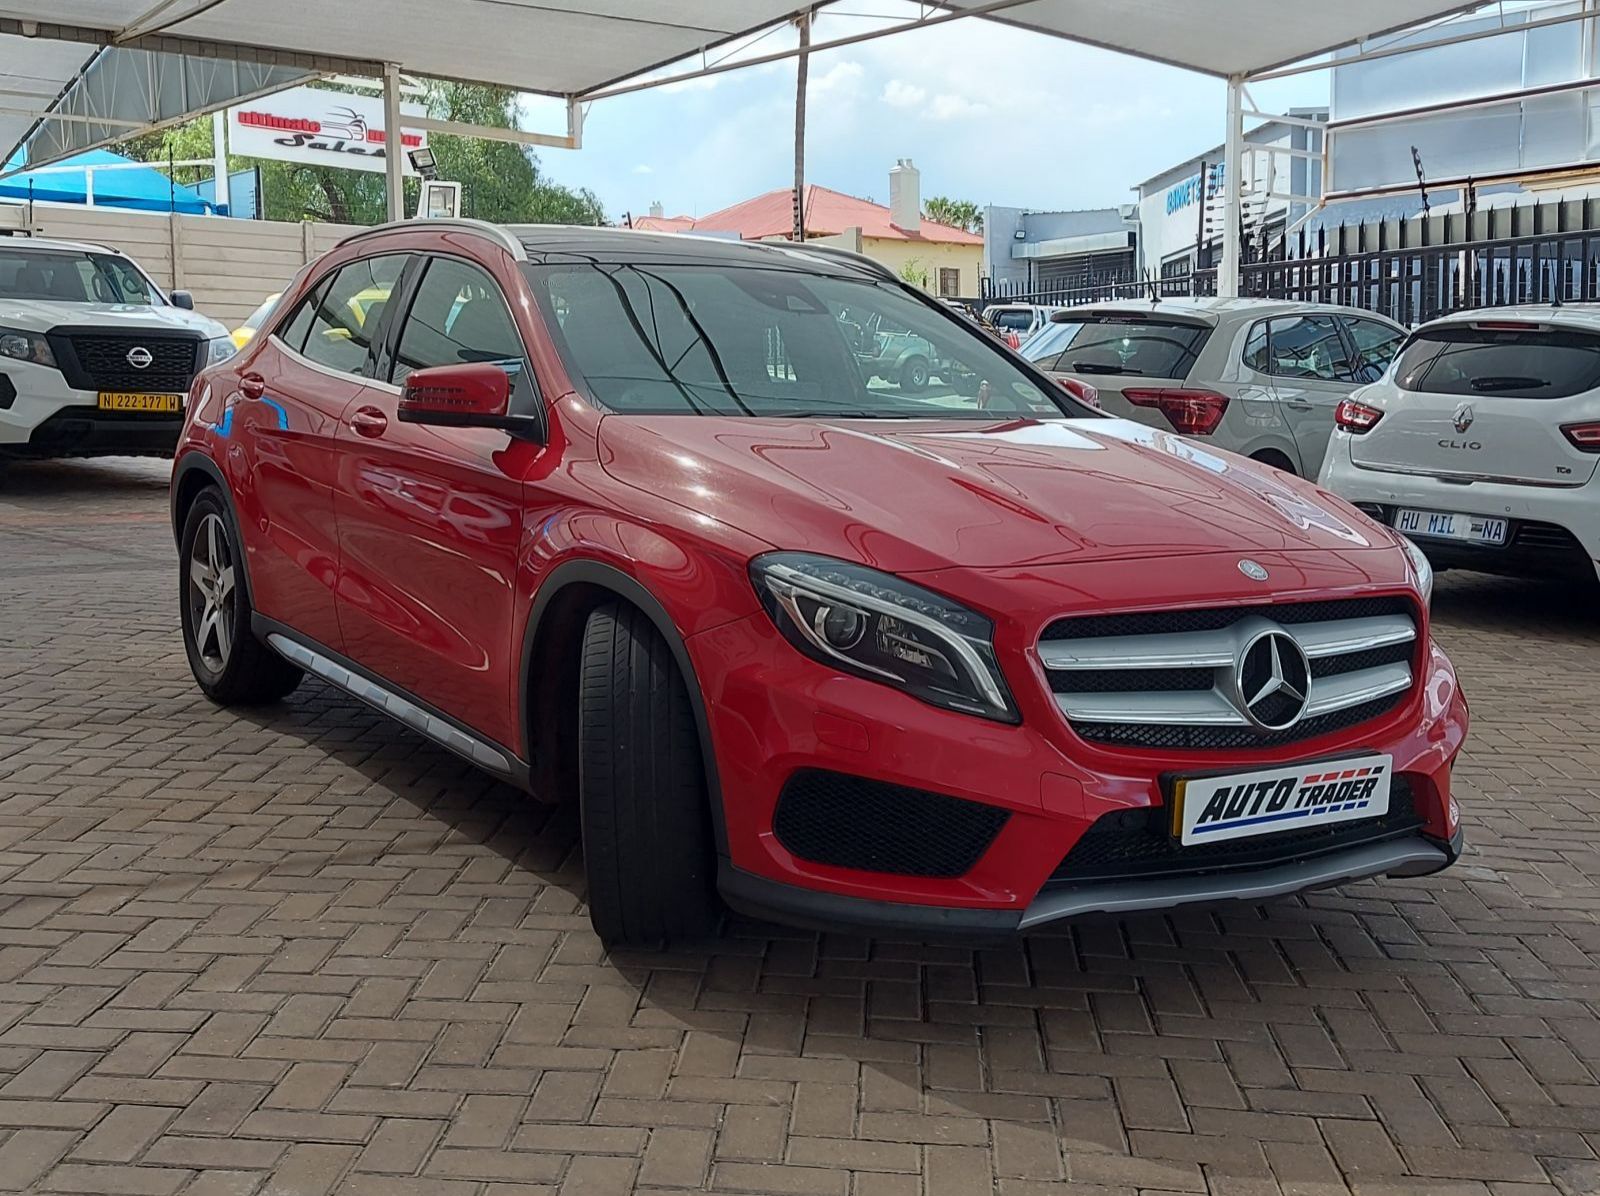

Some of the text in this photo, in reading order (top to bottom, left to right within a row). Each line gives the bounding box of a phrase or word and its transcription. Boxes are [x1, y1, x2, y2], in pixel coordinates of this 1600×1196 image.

[238, 111, 321, 133] ultimate
[104, 394, 111, 407] N
[169, 396, 176, 410] W
[1438, 439, 1482, 451] CLIO
[1555, 466, 1572, 474] TCe
[1400, 512, 1503, 540] HU MIL NA
[1196, 777, 1379, 825] AUTO TRADER
